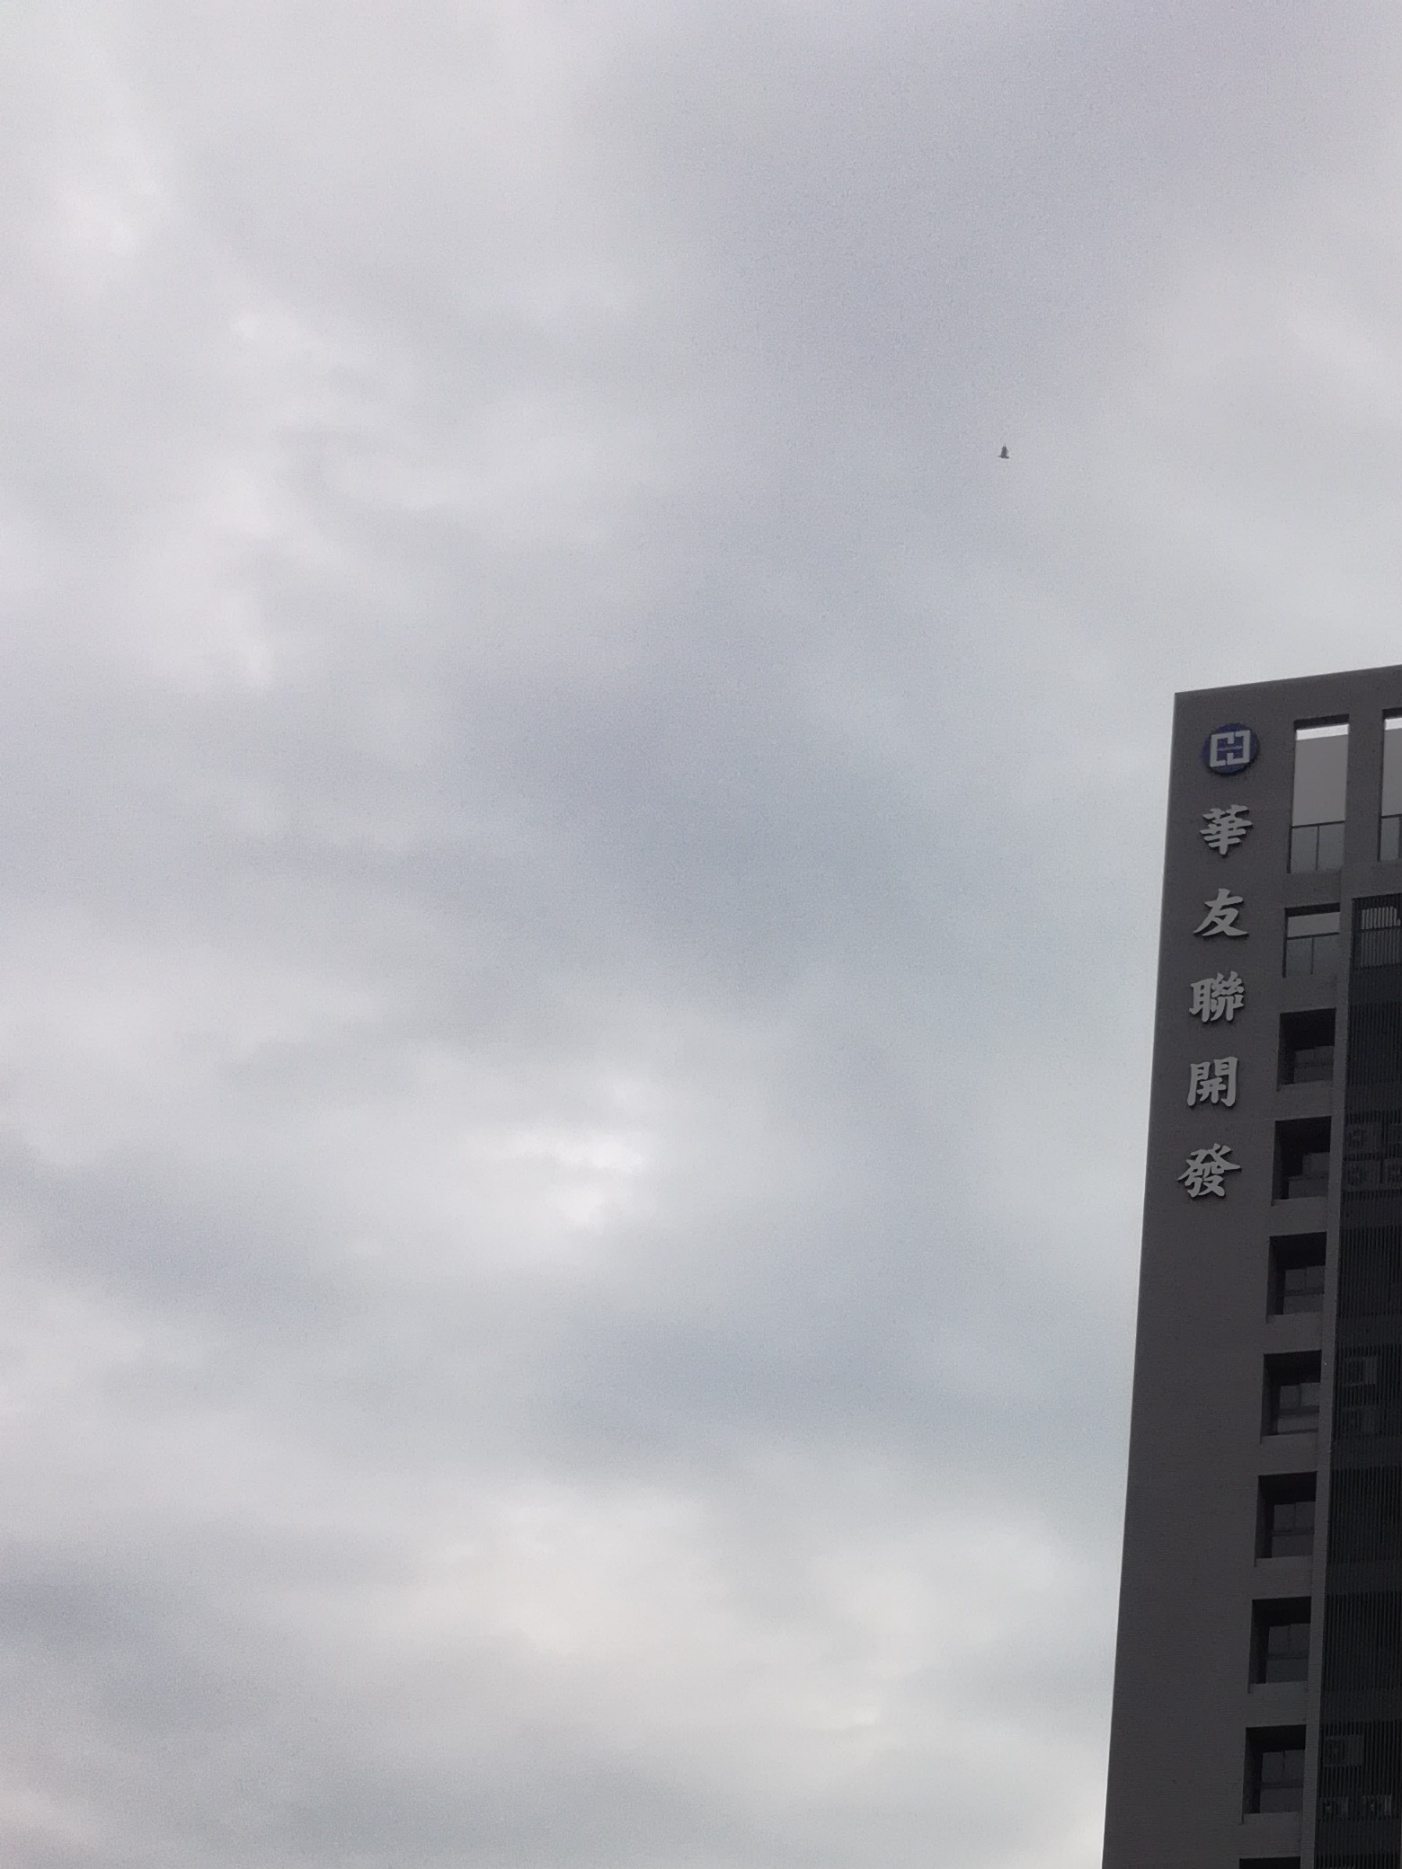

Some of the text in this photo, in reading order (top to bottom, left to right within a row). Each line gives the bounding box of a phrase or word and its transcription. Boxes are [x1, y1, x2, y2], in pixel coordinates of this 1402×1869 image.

[1177, 804, 1253, 1198] 華友聯開發
